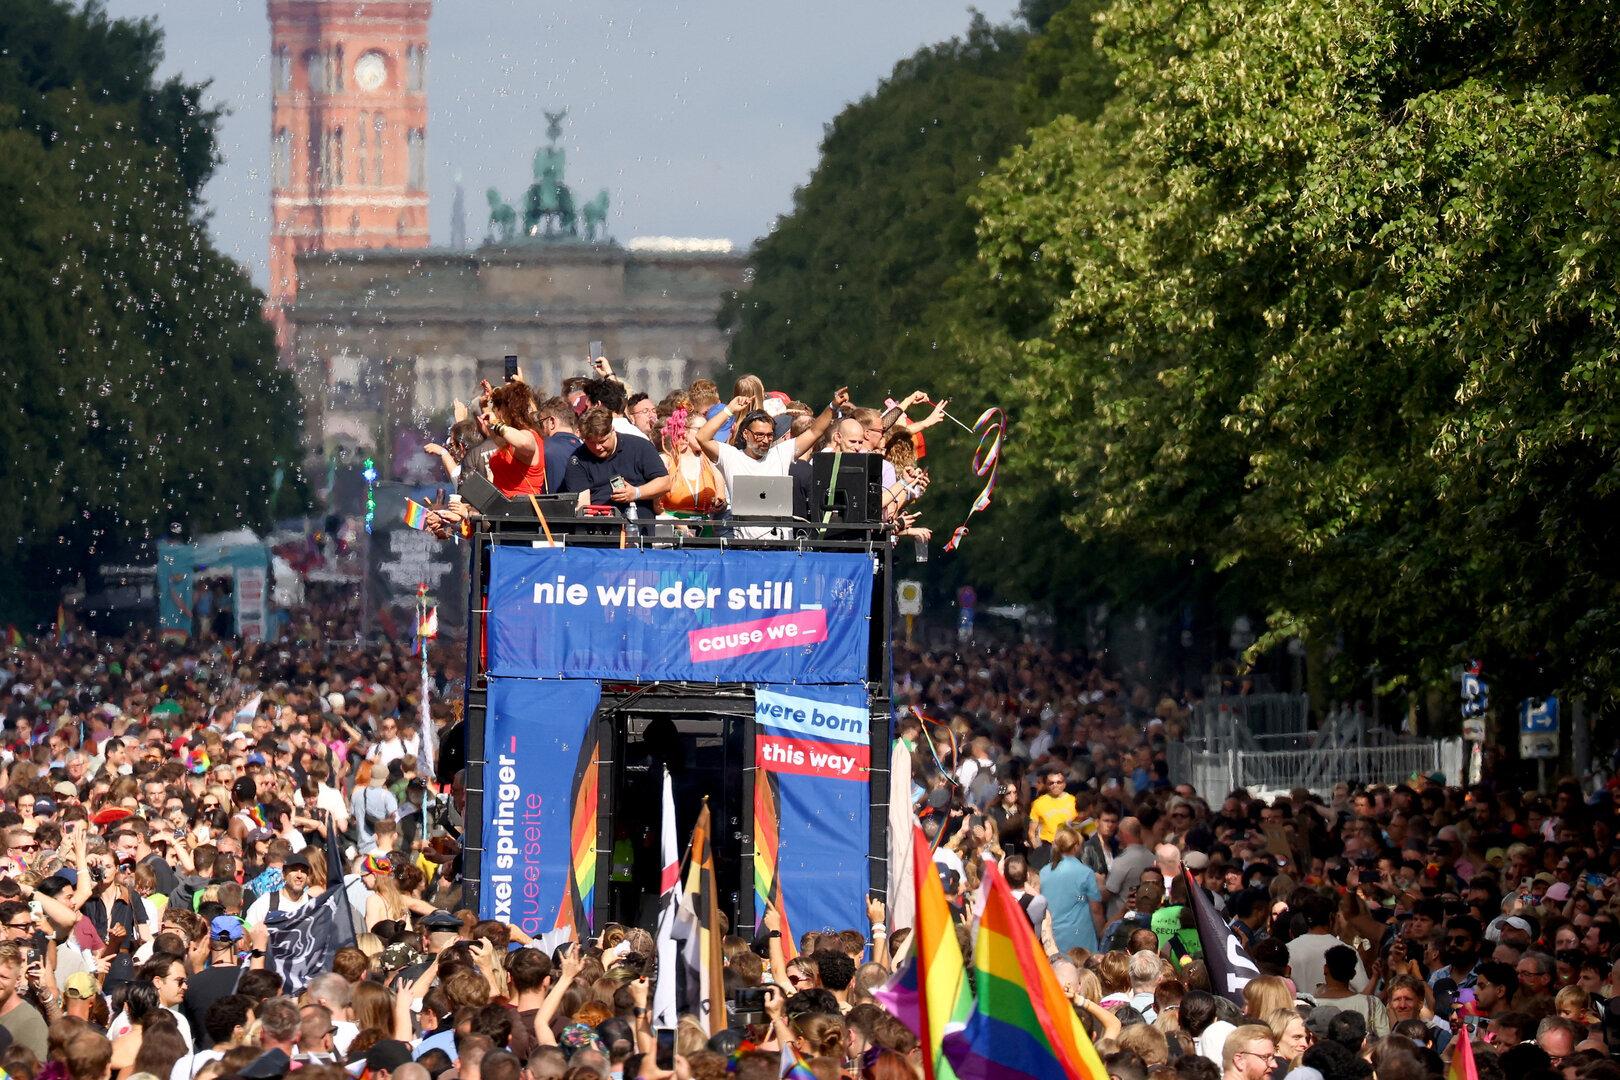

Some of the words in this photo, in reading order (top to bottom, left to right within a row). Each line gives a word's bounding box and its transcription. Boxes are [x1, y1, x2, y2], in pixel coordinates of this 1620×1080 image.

[533, 575, 589, 606] nie
[596, 578, 722, 610] wieder
[727, 580, 793, 610] still
[698, 629, 763, 652] cause
[766, 623, 799, 640] we
[755, 701, 807, 723] were
[811, 708, 863, 734] born
[762, 743, 805, 766] this
[809, 751, 856, 775] way
[492, 754, 521, 869] springer
[522, 793, 544, 934] queerseite
